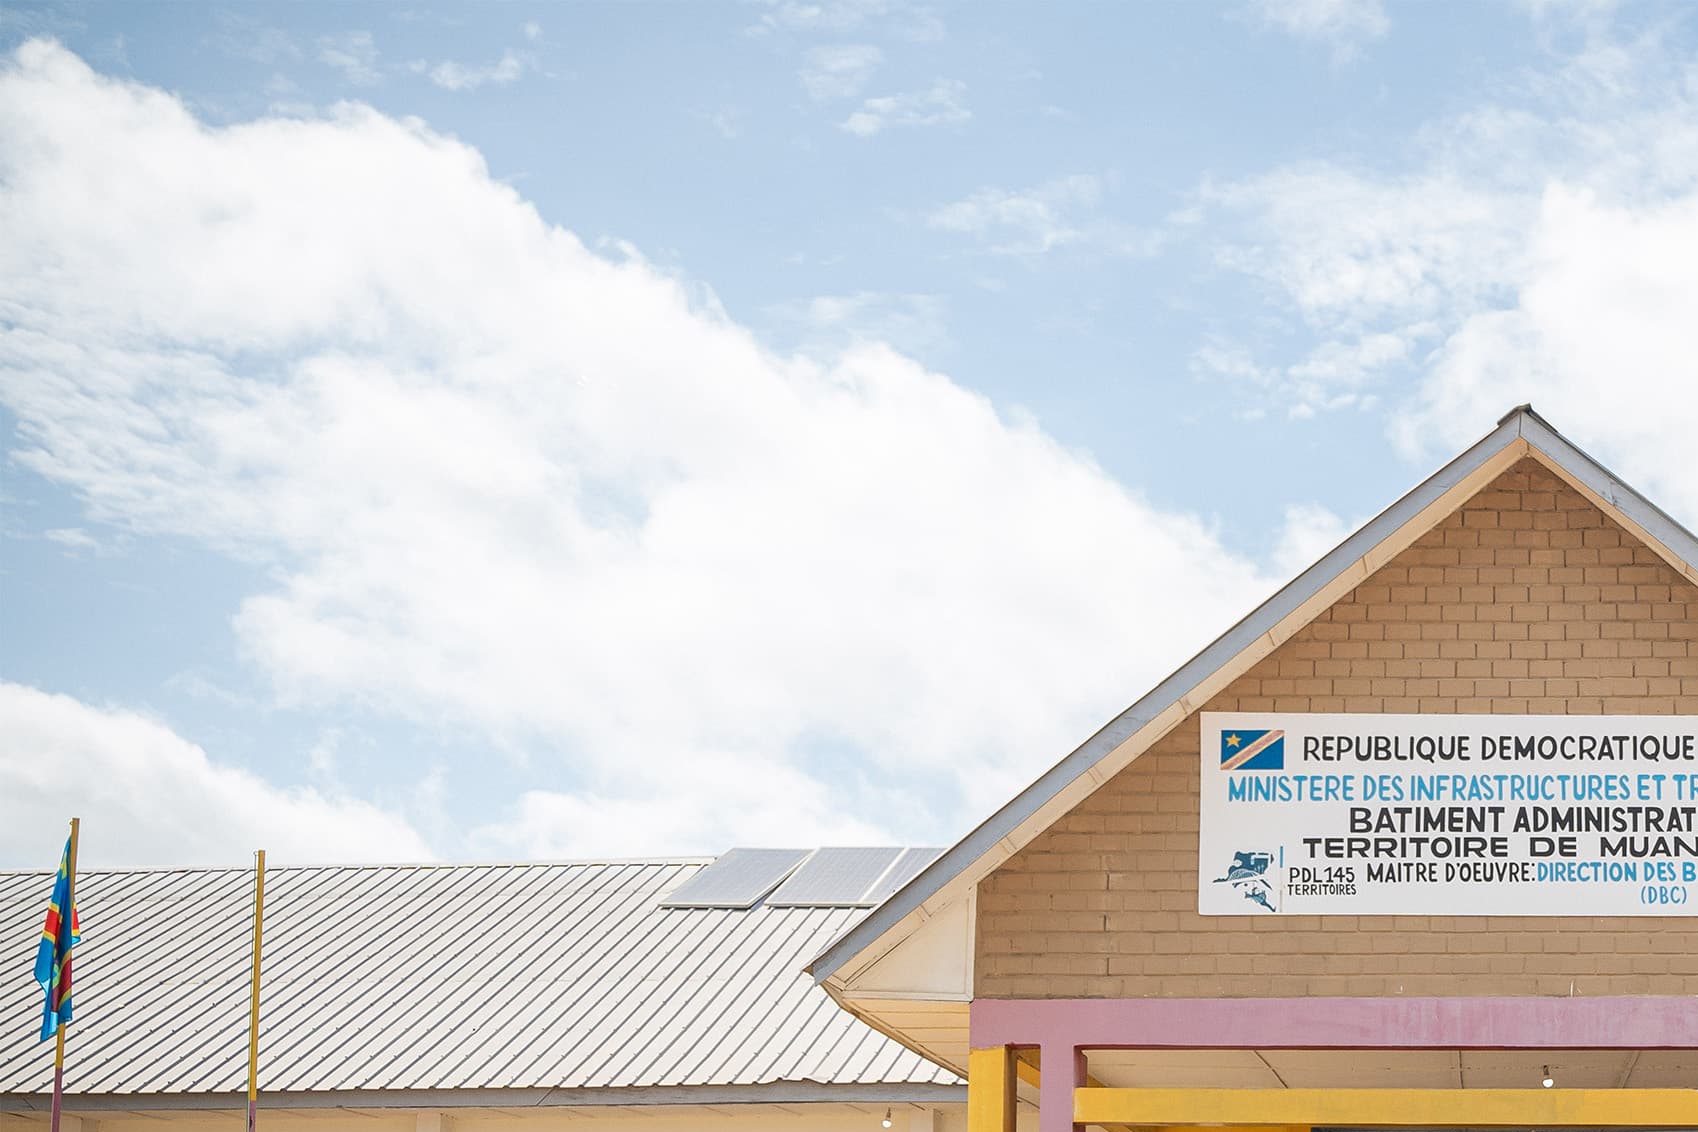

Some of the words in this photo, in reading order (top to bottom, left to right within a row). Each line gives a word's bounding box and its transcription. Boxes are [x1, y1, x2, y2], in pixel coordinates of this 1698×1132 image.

[1302, 735, 1471, 762] REPUBLIQUE
[1481, 735, 1697, 762] DEMOCRATIQUE
[1228, 776, 1355, 803] MINISTERE
[1362, 776, 1405, 802] DES
[1410, 775, 1631, 802] INFRASTRUCTURES
[1637, 775, 1666, 801] ET
[1349, 806, 1502, 834] BATIMENT
[1303, 836, 1508, 859] TERRITOIRE
[1530, 836, 1577, 858] DE
[1367, 862, 1438, 883] MAITRE
[1537, 861, 1639, 883] DIRECTION
[1643, 861, 1677, 882] DES
[1287, 883, 1357, 896] TERRITOIRES
[1640, 884, 1688, 905] (DBC)
